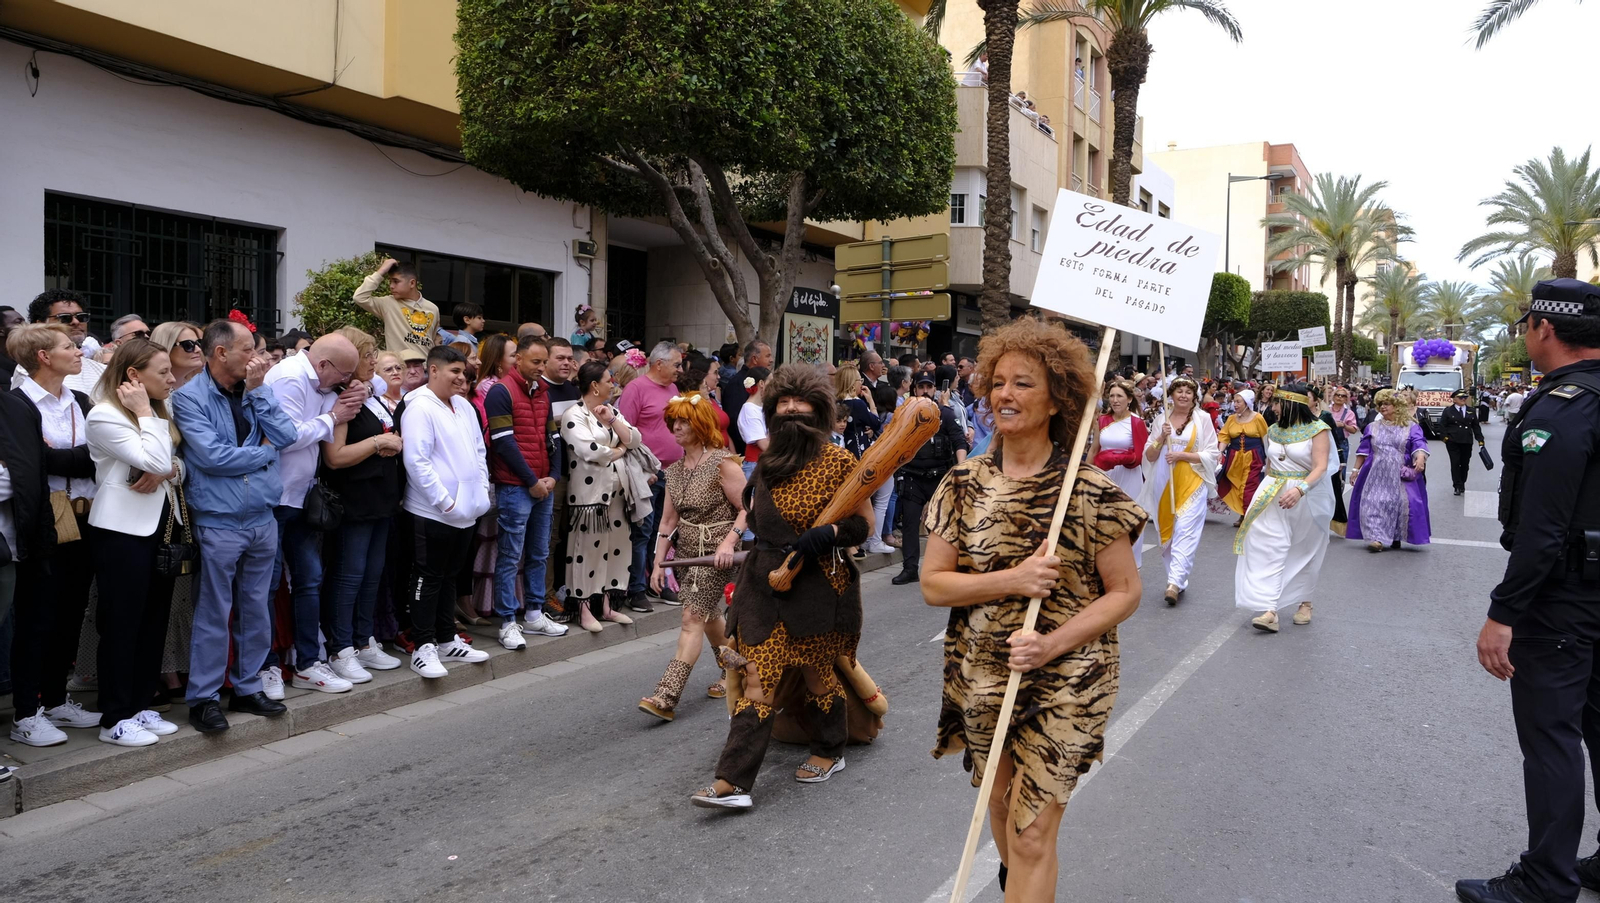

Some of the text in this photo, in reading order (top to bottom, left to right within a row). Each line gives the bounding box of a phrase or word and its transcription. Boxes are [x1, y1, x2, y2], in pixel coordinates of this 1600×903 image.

[1076, 202, 1200, 258] Edad de
[1074, 240, 1177, 276] piedra
[1059, 257, 1172, 296] ESTO FORMA PARTE
[1094, 286, 1166, 315] DEL PASADO
[1263, 343, 1282, 351] Edad
